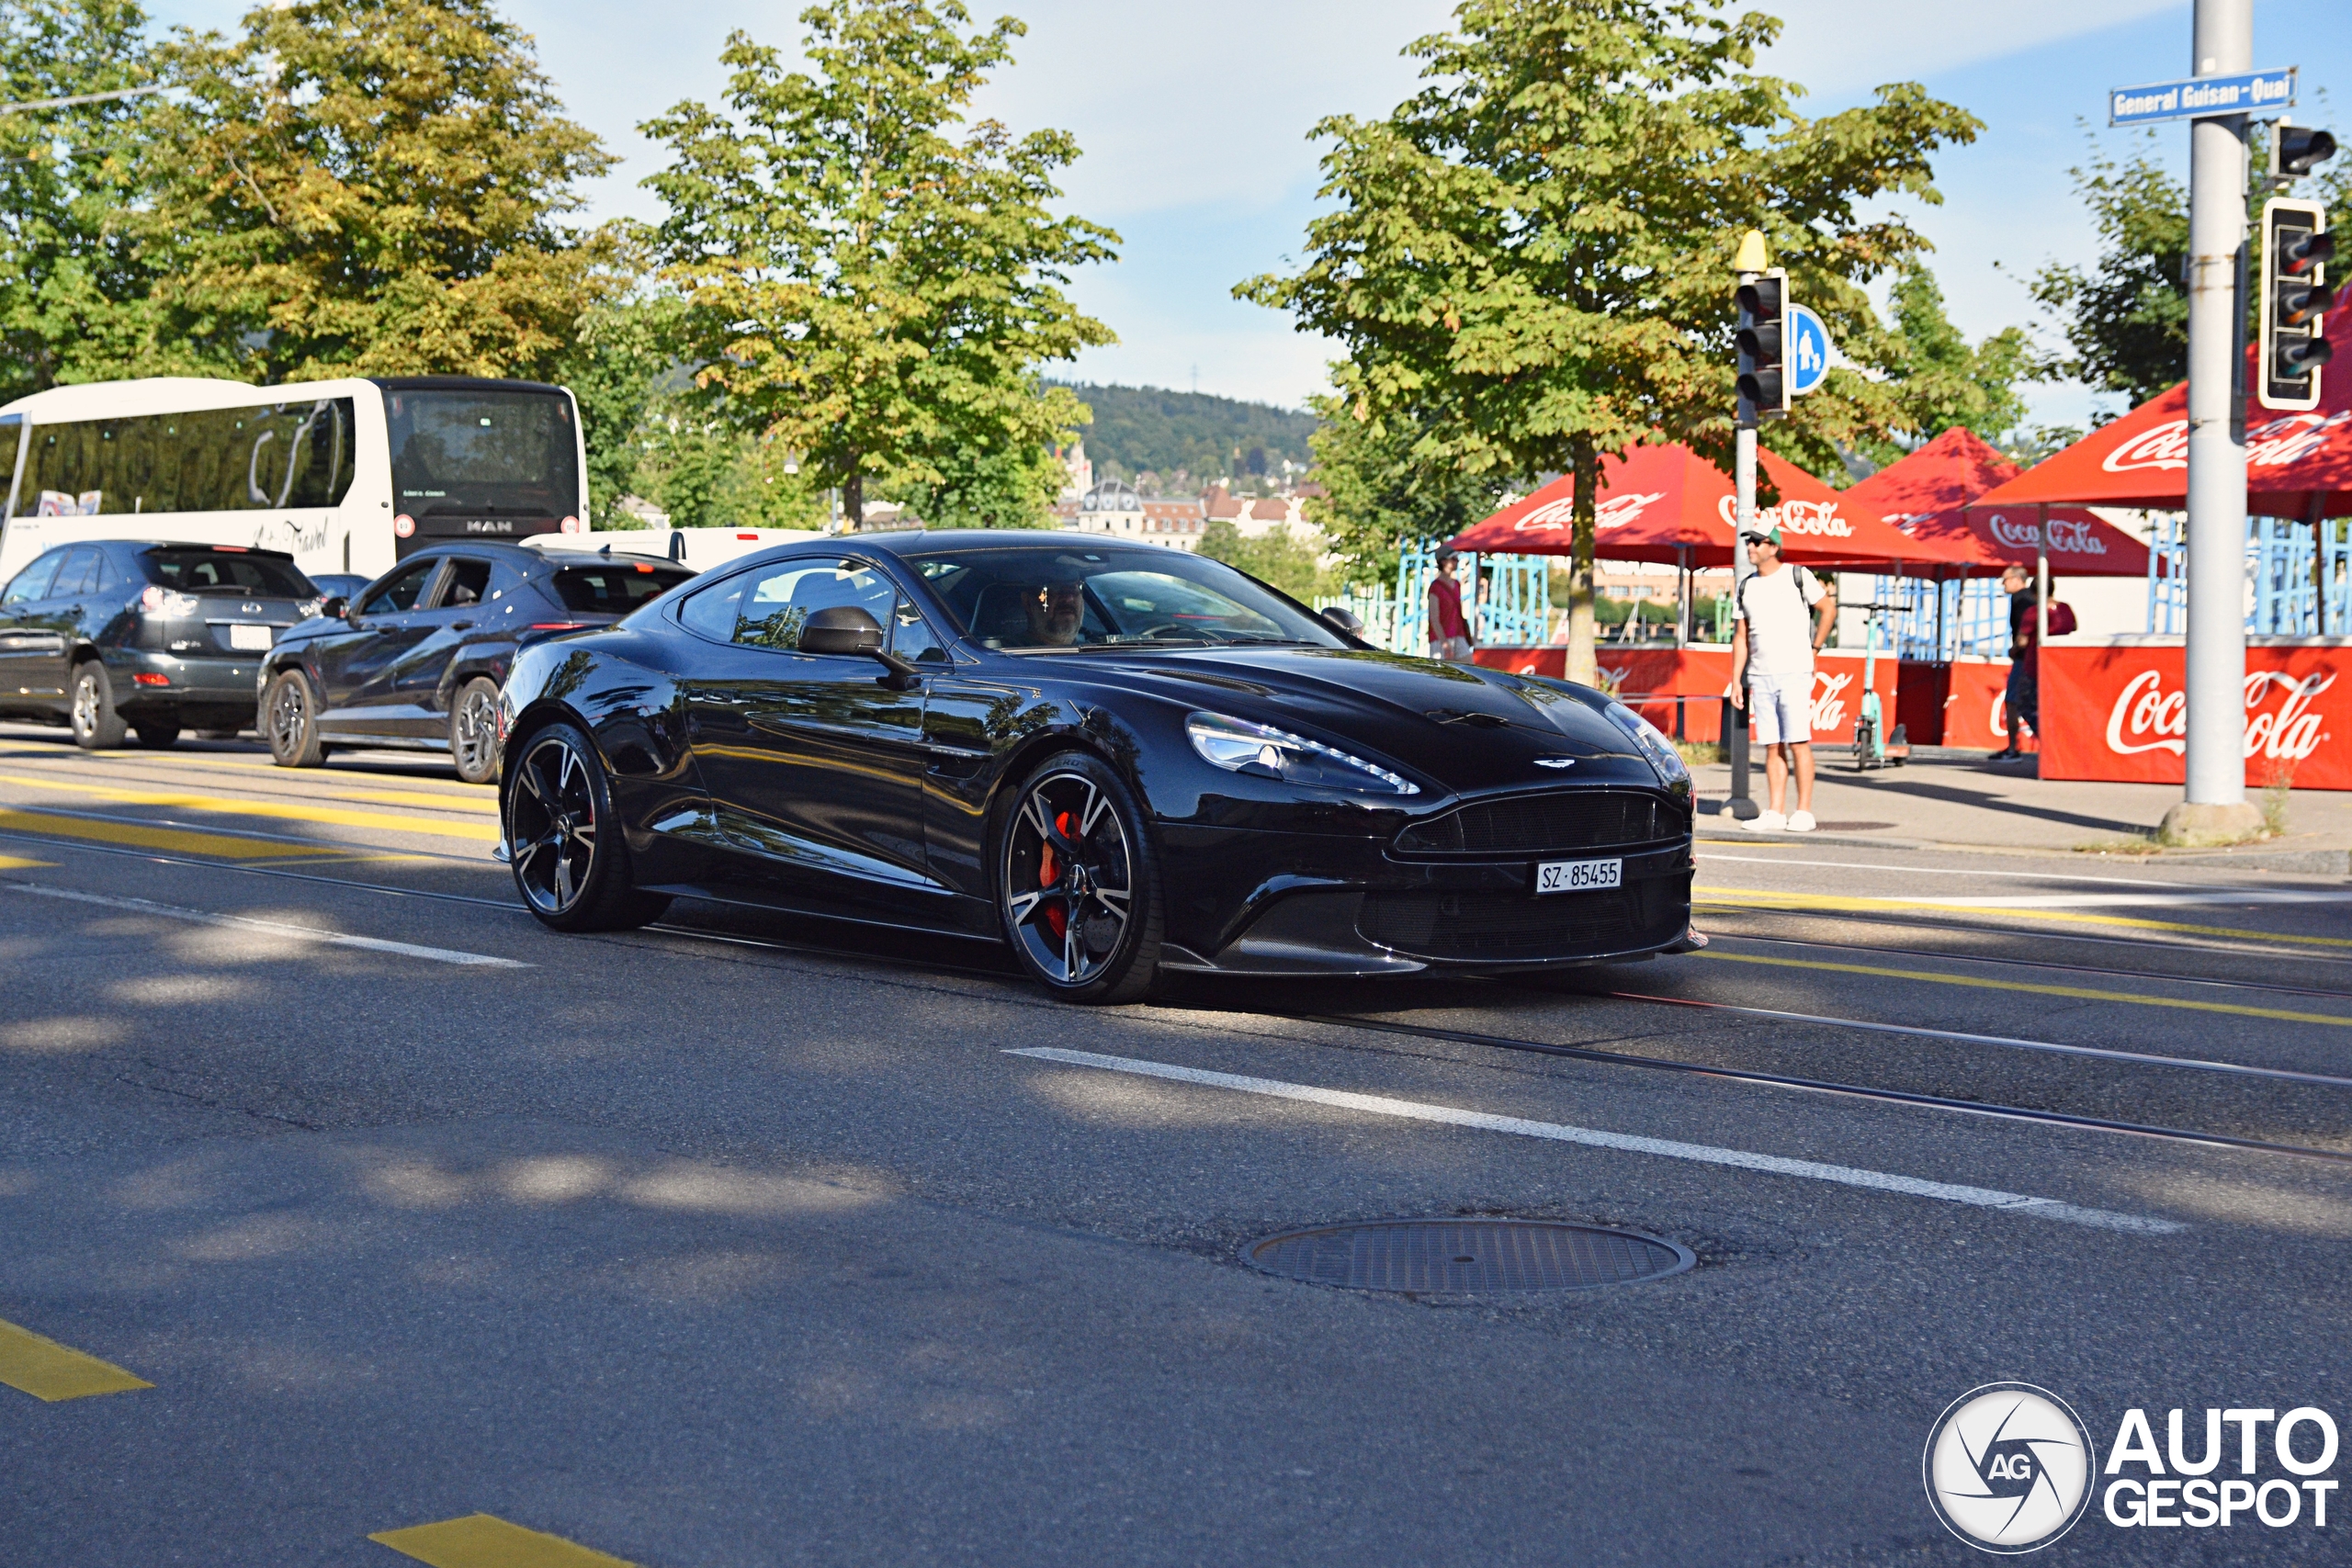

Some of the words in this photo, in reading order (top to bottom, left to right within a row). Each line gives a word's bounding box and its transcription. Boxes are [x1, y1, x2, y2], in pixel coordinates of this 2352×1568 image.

[2114, 88, 2177, 116] General
[2181, 75, 2290, 109] Guisan-Quai
[2102, 410, 2352, 471] Cocola
[466, 520, 513, 533] MAN
[1514, 491, 1668, 531] Cocaola
[1718, 494, 1853, 537] Ca-Cola
[1989, 513, 2108, 555] CocaCola
[2106, 670, 2339, 760] Cocola
[1542, 866, 1562, 888] SZ
[1571, 862, 1618, 886] 85455
